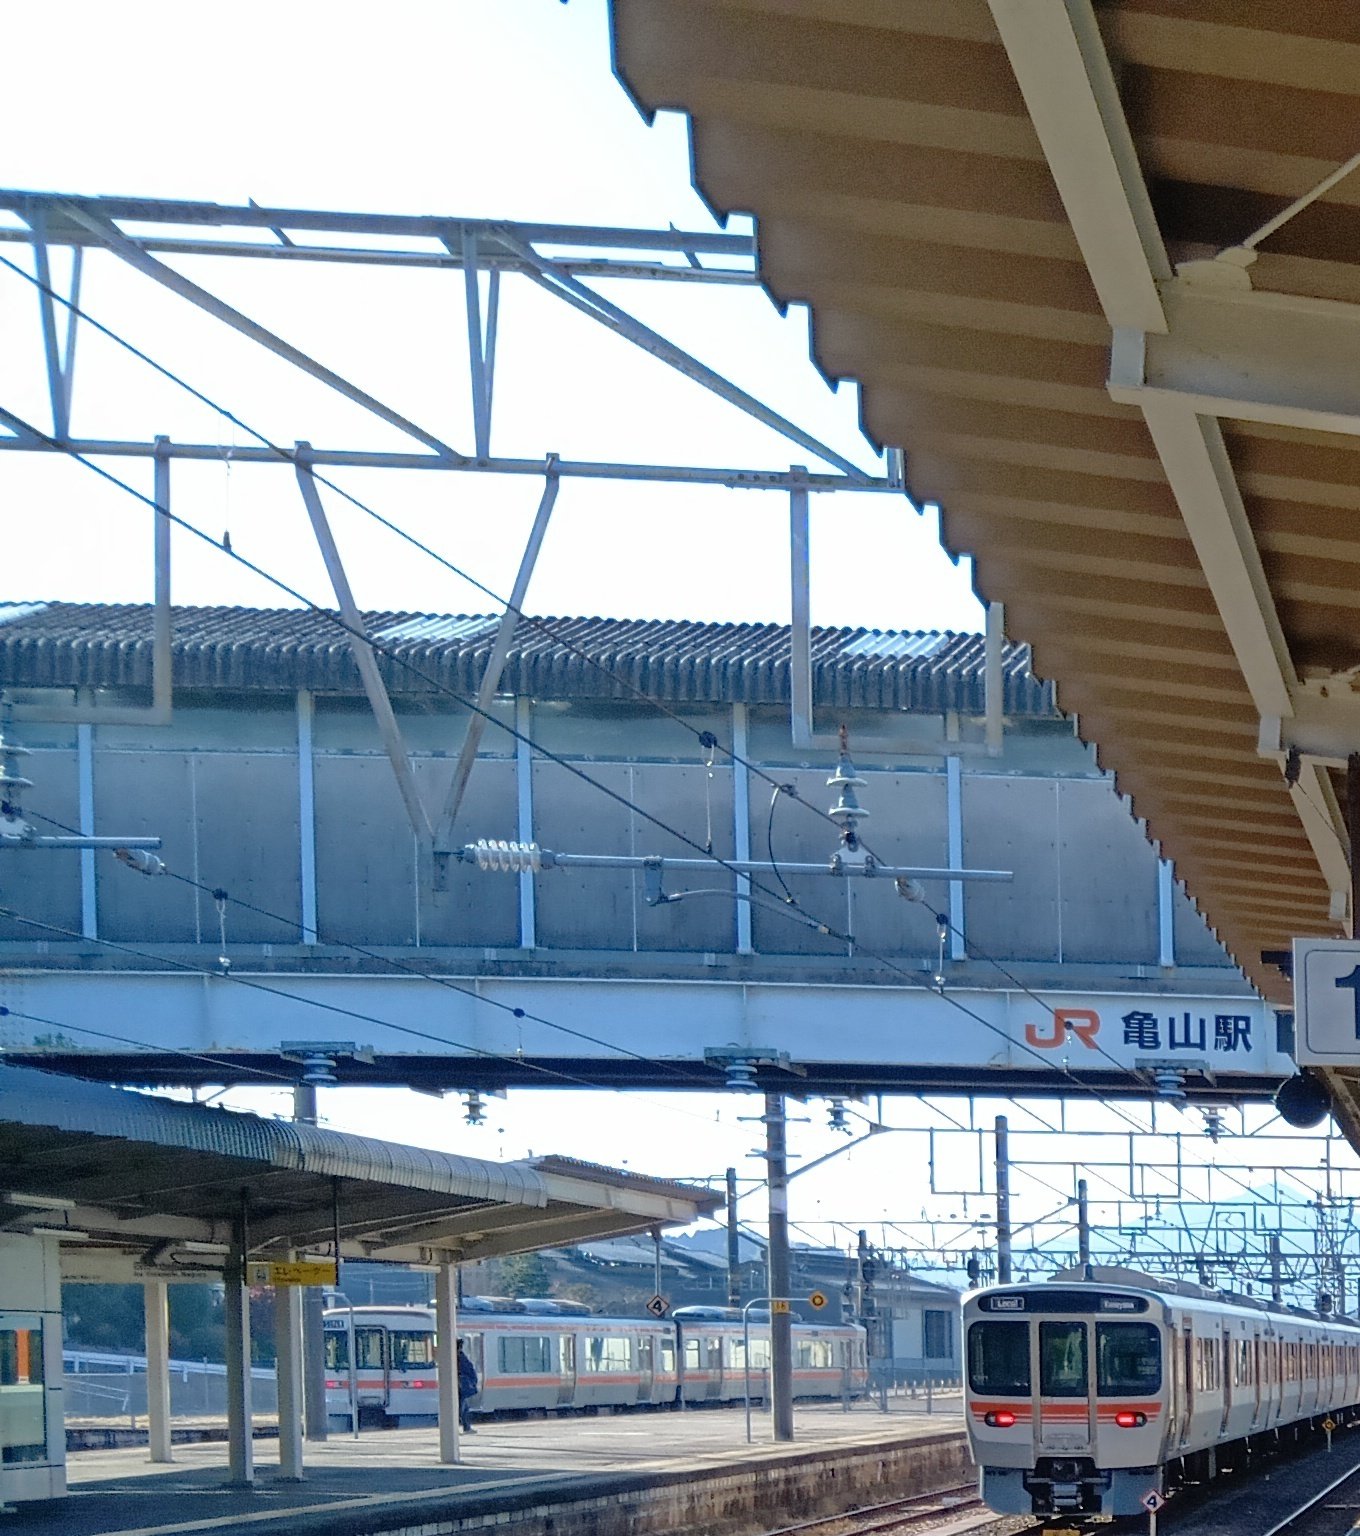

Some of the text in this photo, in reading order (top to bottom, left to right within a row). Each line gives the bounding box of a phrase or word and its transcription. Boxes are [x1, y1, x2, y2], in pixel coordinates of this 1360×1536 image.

[1025, 1008, 1254, 1052] JR 亀山駅
[652, 1299, 664, 1313] 4
[1146, 1496, 1158, 1507] 4
